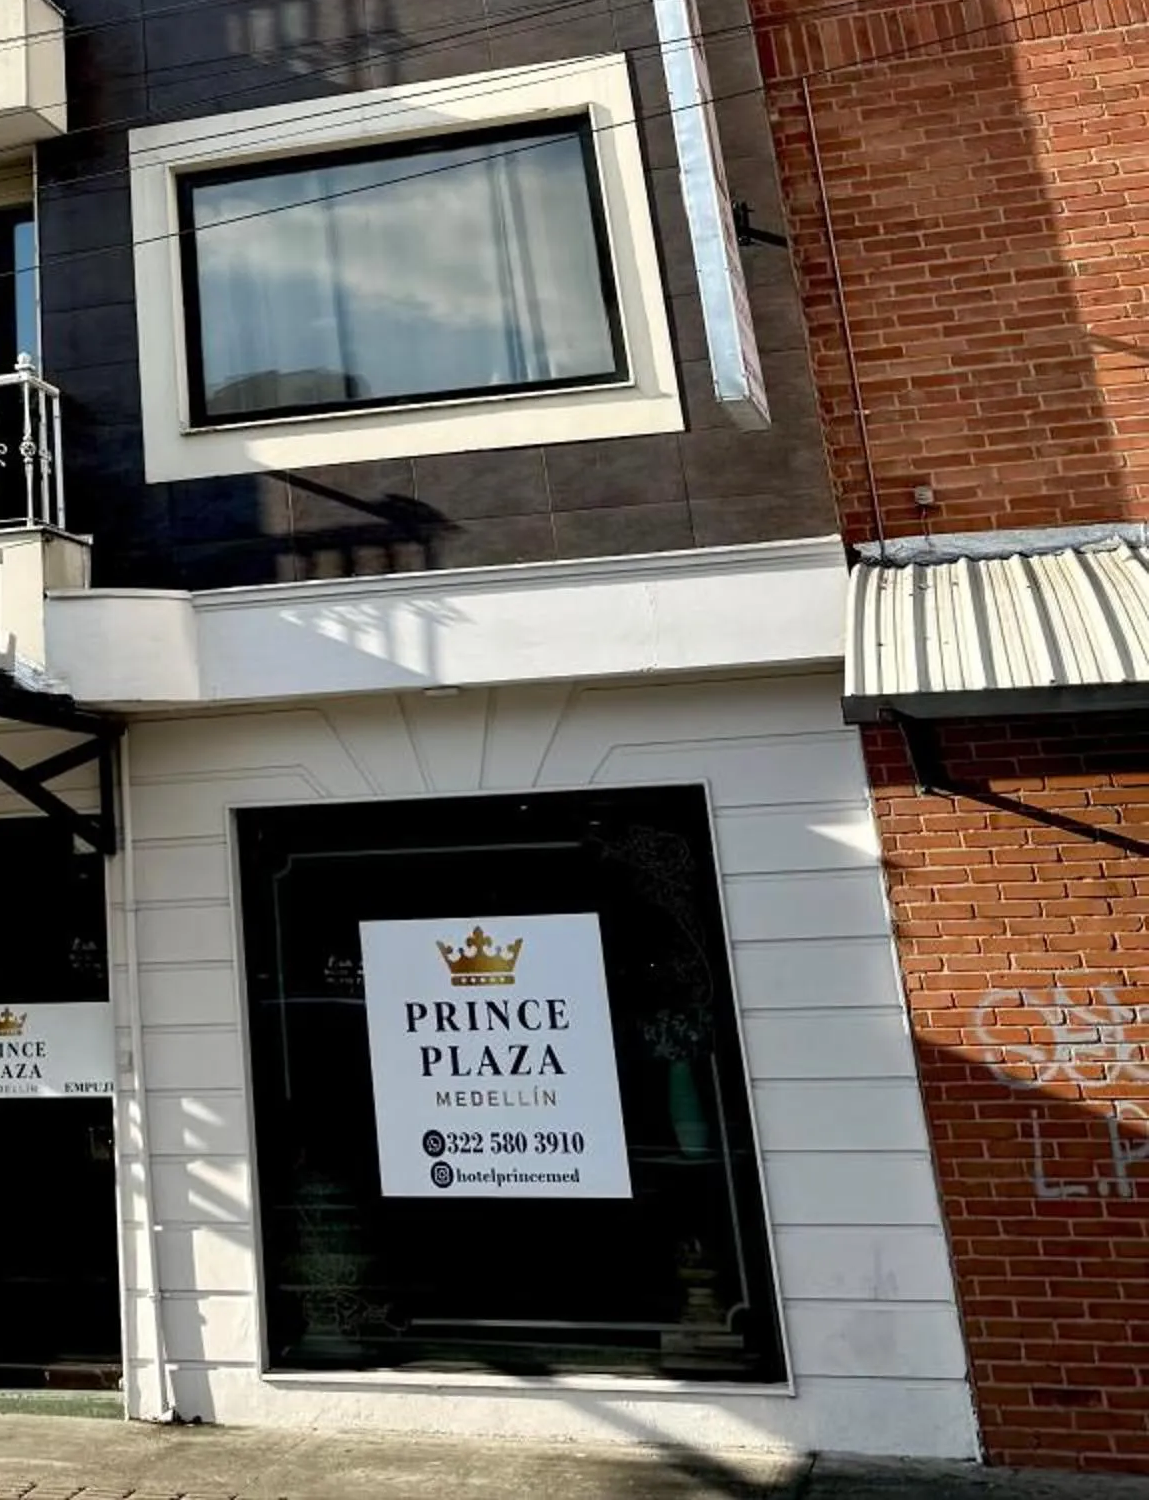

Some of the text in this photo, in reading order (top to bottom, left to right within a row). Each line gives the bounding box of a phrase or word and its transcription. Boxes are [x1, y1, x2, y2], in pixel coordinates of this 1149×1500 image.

[404, 999, 570, 1033] PRINCE
[419, 1043, 566, 1077] PLAZA
[436, 1084, 557, 1107] MEDELLÍN
[446, 1131, 585, 1155] 322 580 3910
[455, 1167, 581, 1187] hotelprincemed
